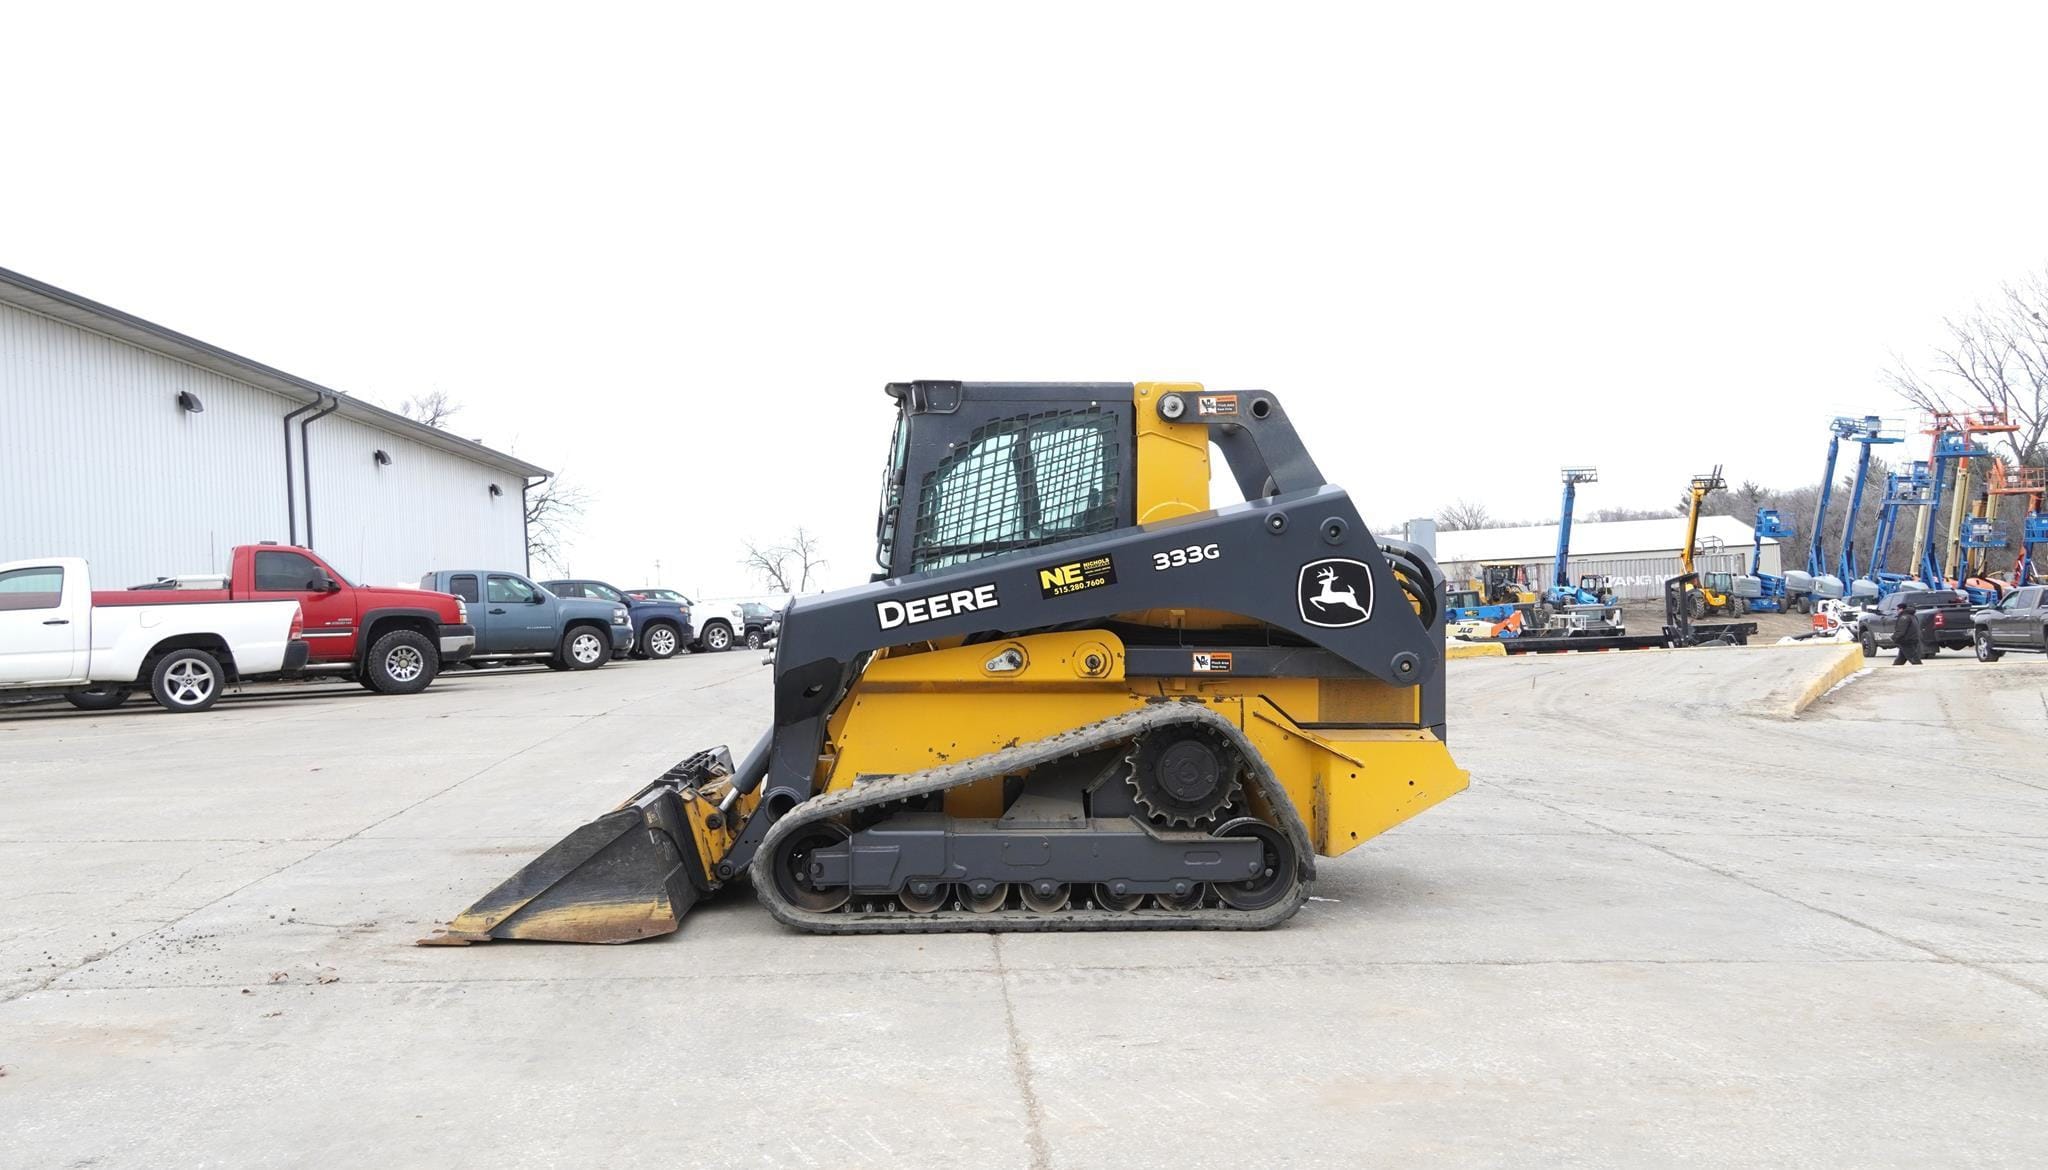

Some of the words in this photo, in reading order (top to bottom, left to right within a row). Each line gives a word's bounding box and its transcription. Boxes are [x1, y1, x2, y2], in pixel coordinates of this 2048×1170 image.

[1153, 543, 1220, 570] 333G
[1040, 563, 1084, 589] NE
[1054, 578, 1105, 595] 515.280.7600
[877, 584, 998, 629] DEERE
